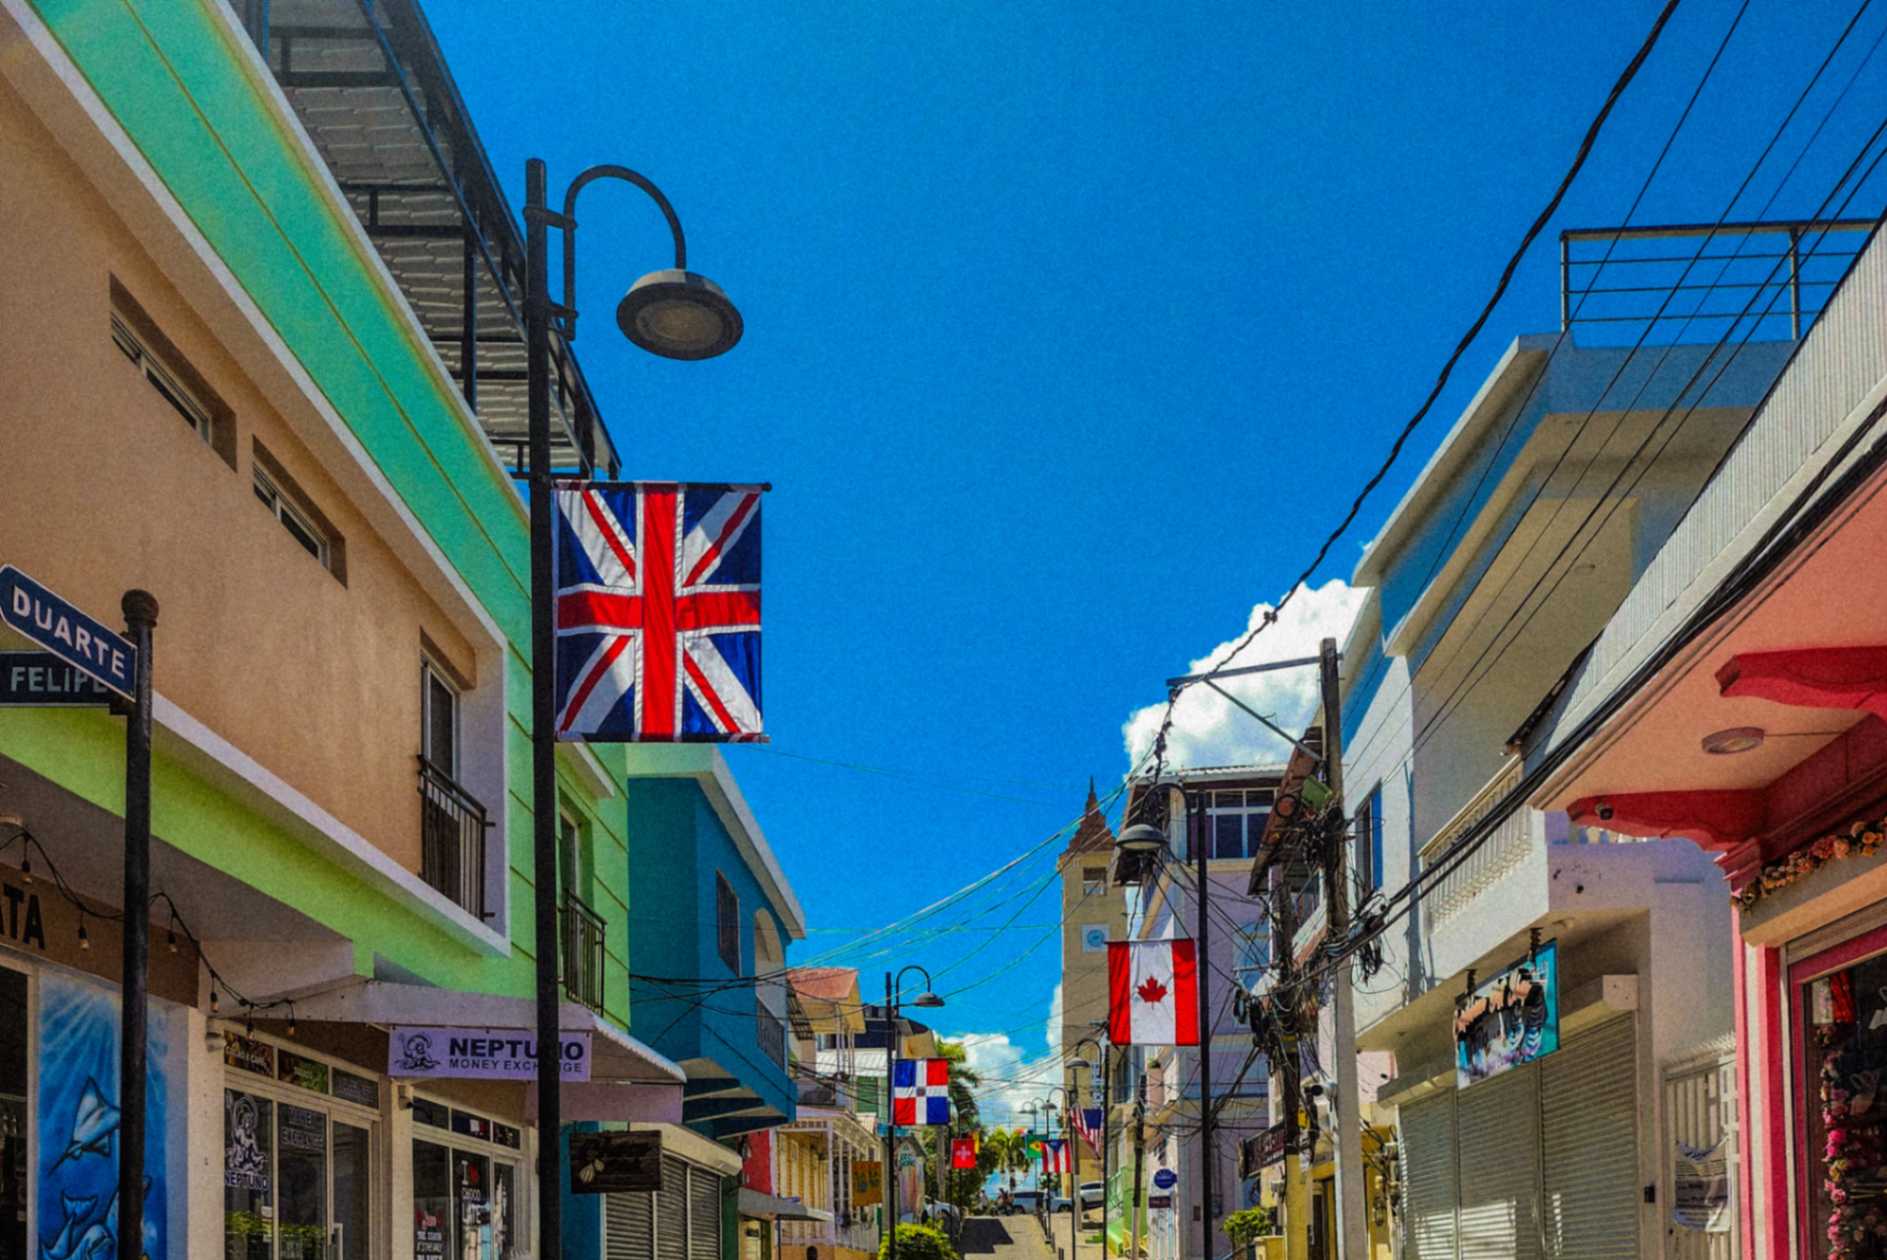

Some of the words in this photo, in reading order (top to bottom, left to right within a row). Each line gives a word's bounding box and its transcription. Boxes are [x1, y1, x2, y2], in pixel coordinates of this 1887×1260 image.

[12, 584, 125, 680] DUARTE
[449, 1038, 584, 1060] NEPTUO
[449, 1058, 500, 1070] MONEY
